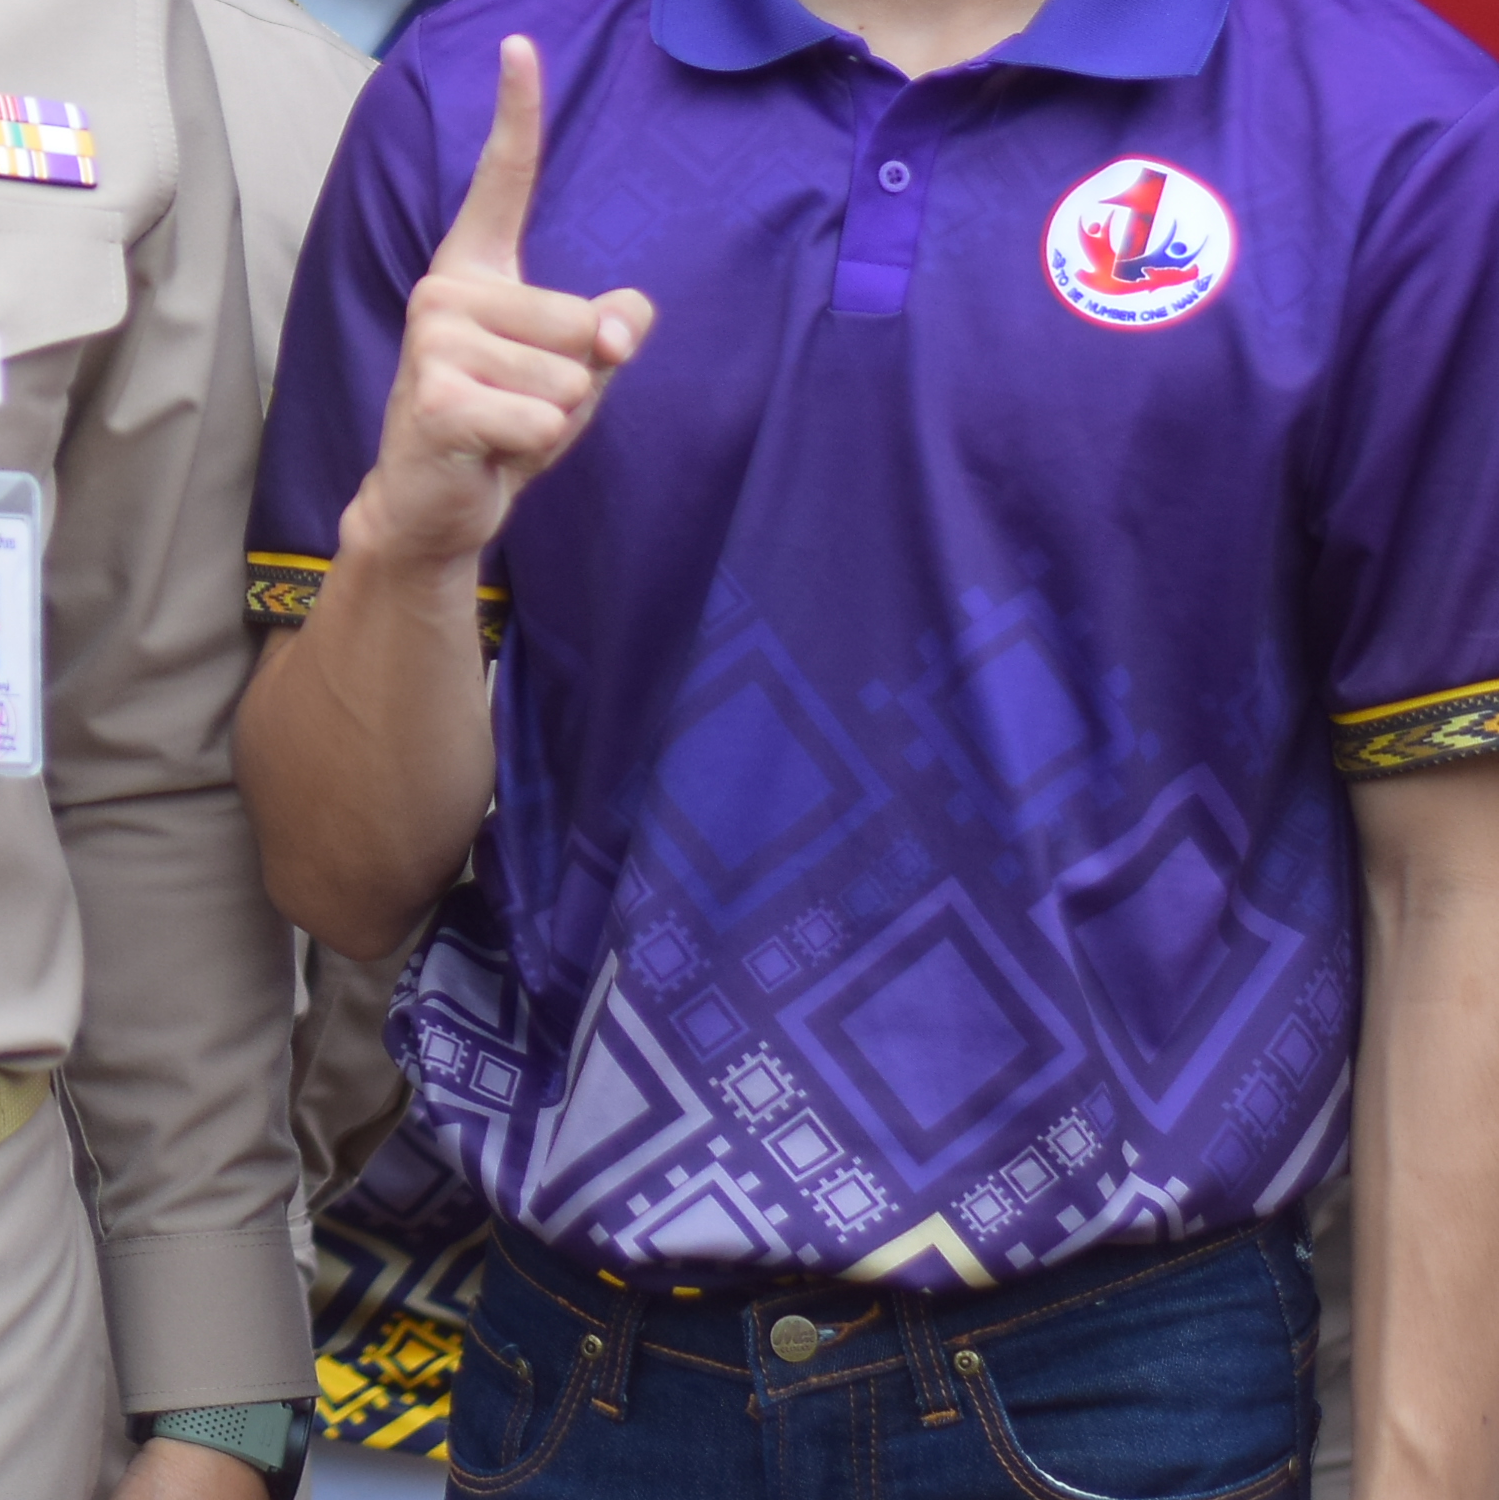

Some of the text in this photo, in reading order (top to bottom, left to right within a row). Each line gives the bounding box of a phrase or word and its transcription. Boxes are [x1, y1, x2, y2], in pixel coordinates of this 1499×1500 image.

[1055, 268, 1070, 287] TO
[1084, 300, 1137, 323] NUMBER
[1140, 306, 1169, 322] ONE
[1171, 290, 1200, 312] NAN
